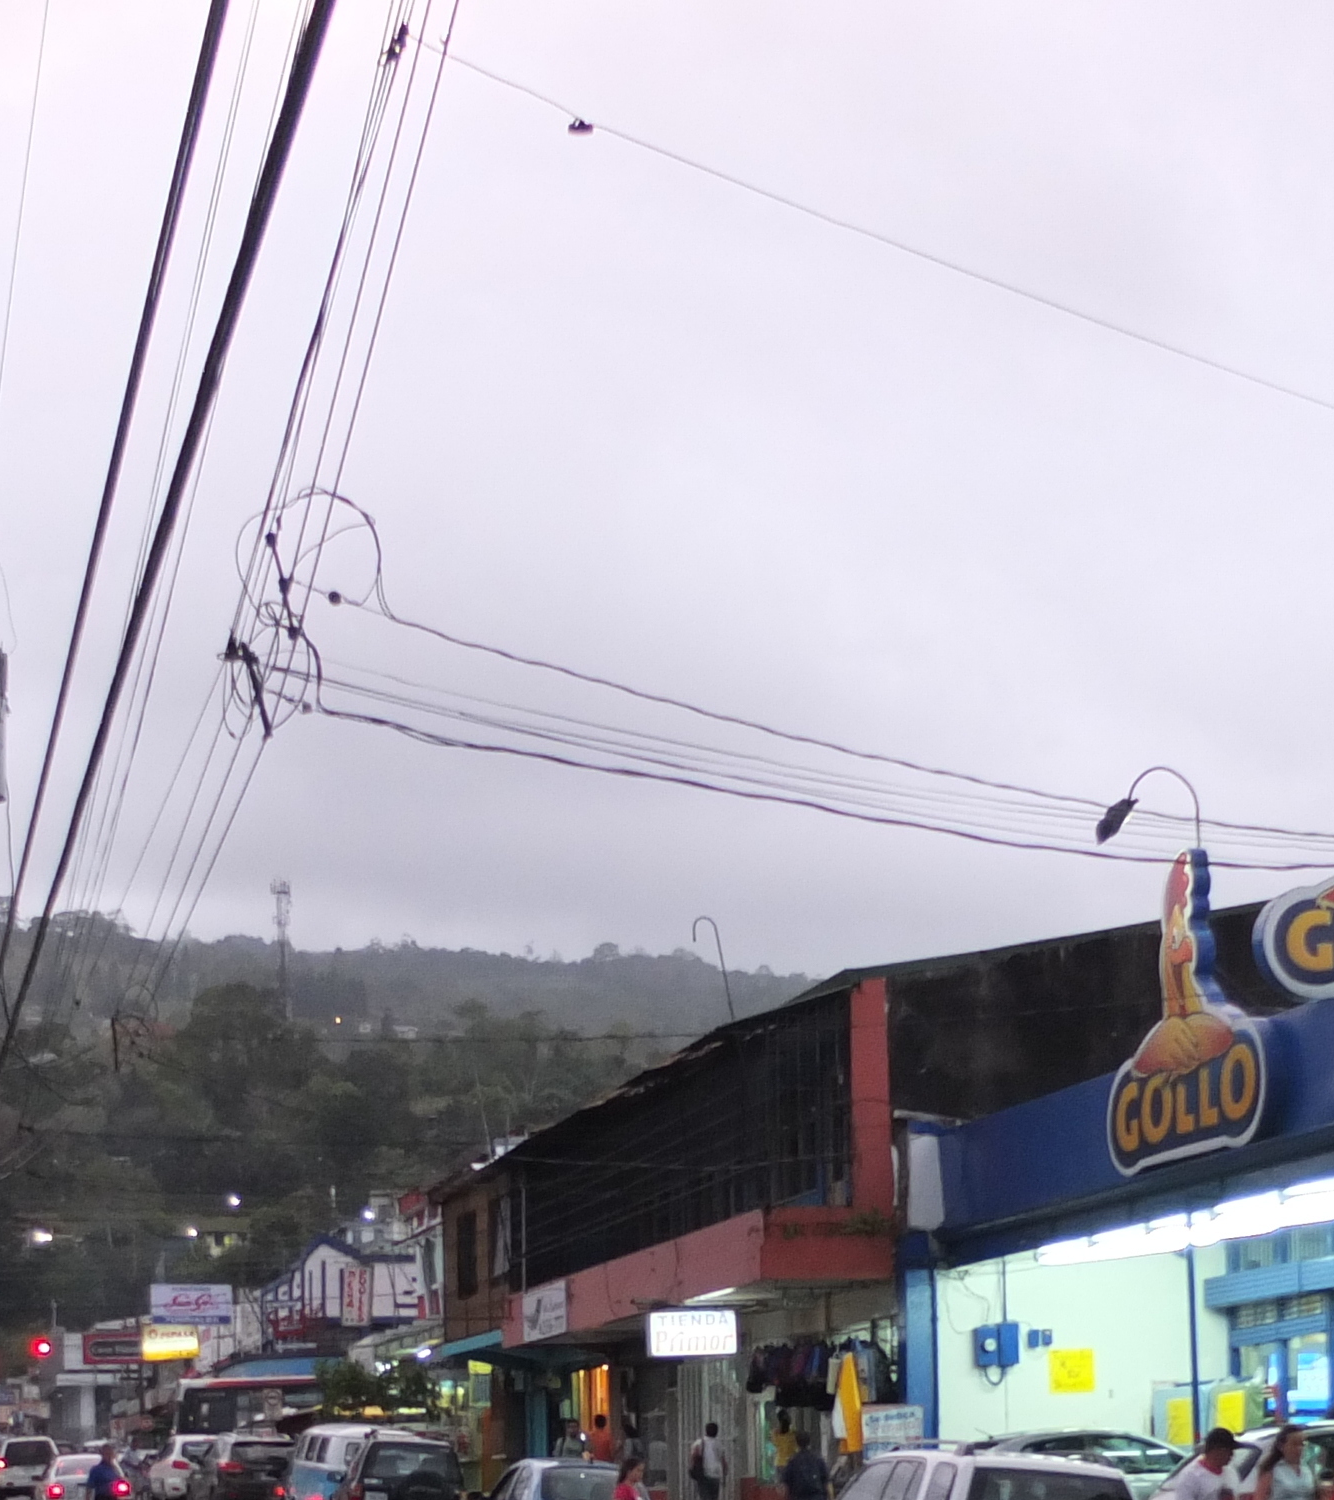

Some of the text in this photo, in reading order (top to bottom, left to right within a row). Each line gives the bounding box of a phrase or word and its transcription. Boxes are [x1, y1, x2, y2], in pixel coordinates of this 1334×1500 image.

[1115, 1042, 1256, 1153] GOLLO
[657, 1311, 729, 1327] TIENDA
[655, 1330, 734, 1353] Primor
